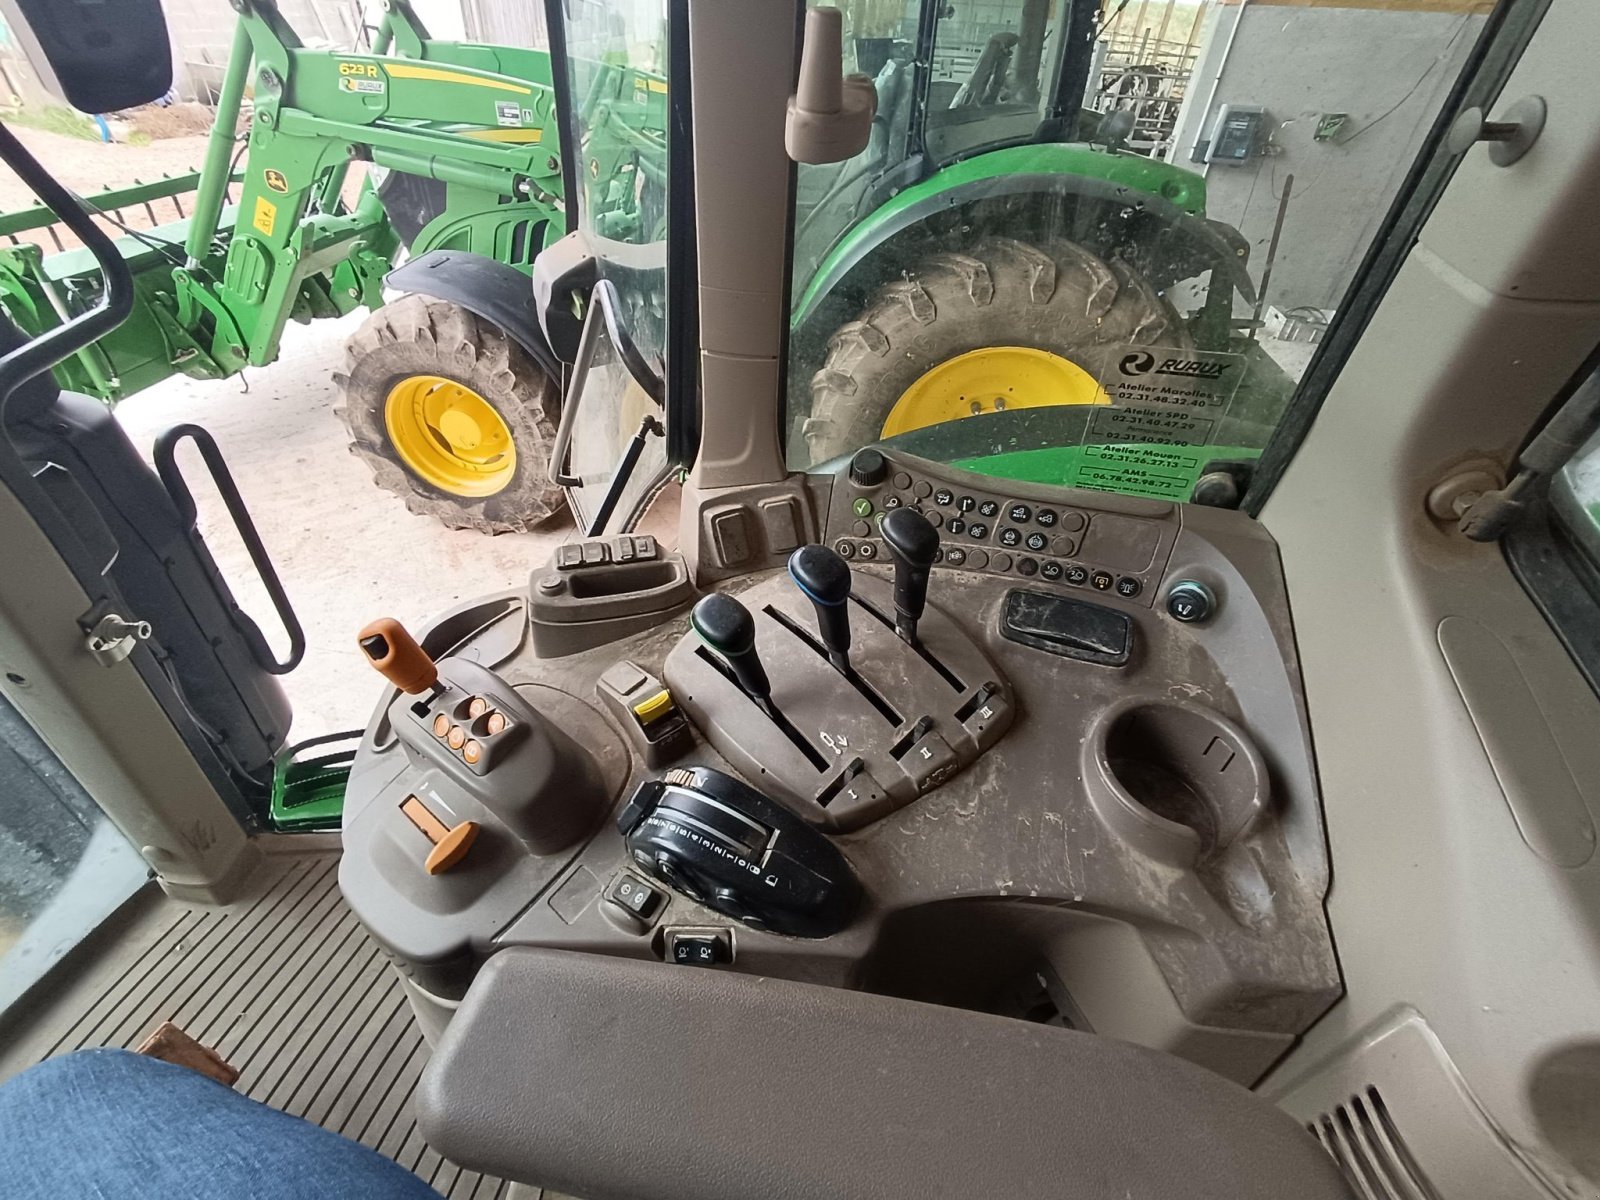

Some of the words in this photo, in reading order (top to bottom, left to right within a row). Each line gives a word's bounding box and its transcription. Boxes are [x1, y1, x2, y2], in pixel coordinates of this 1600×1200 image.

[339, 63, 365, 76] 623
[367, 65, 378, 78] R
[1159, 358, 1232, 375] RUAUX
[1118, 382, 1158, 393] Atelier
[1160, 386, 1213, 399] Marolles
[1118, 392, 1206, 408] 02.31.48.32.40
[1123, 407, 1162, 417] Atelier
[1166, 411, 1189, 420] SPD
[1111, 414, 1196, 430] 02.31.40.47.29
[1106, 432, 1188, 447] 02.31.40.92.90
[1103, 445, 1141, 455] Atelier
[1142, 449, 1181, 460] Mouen
[1100, 453, 1179, 468] 02.31.26.27.13
[1092, 472, 1172, 488] 06.78.42.98.72
[1121, 468, 1148, 477] AMS
[679, 828, 687, 836] 5
[702, 839, 710, 847] 3
[714, 846, 722, 854] 2
[738, 859, 746, 867] 0
